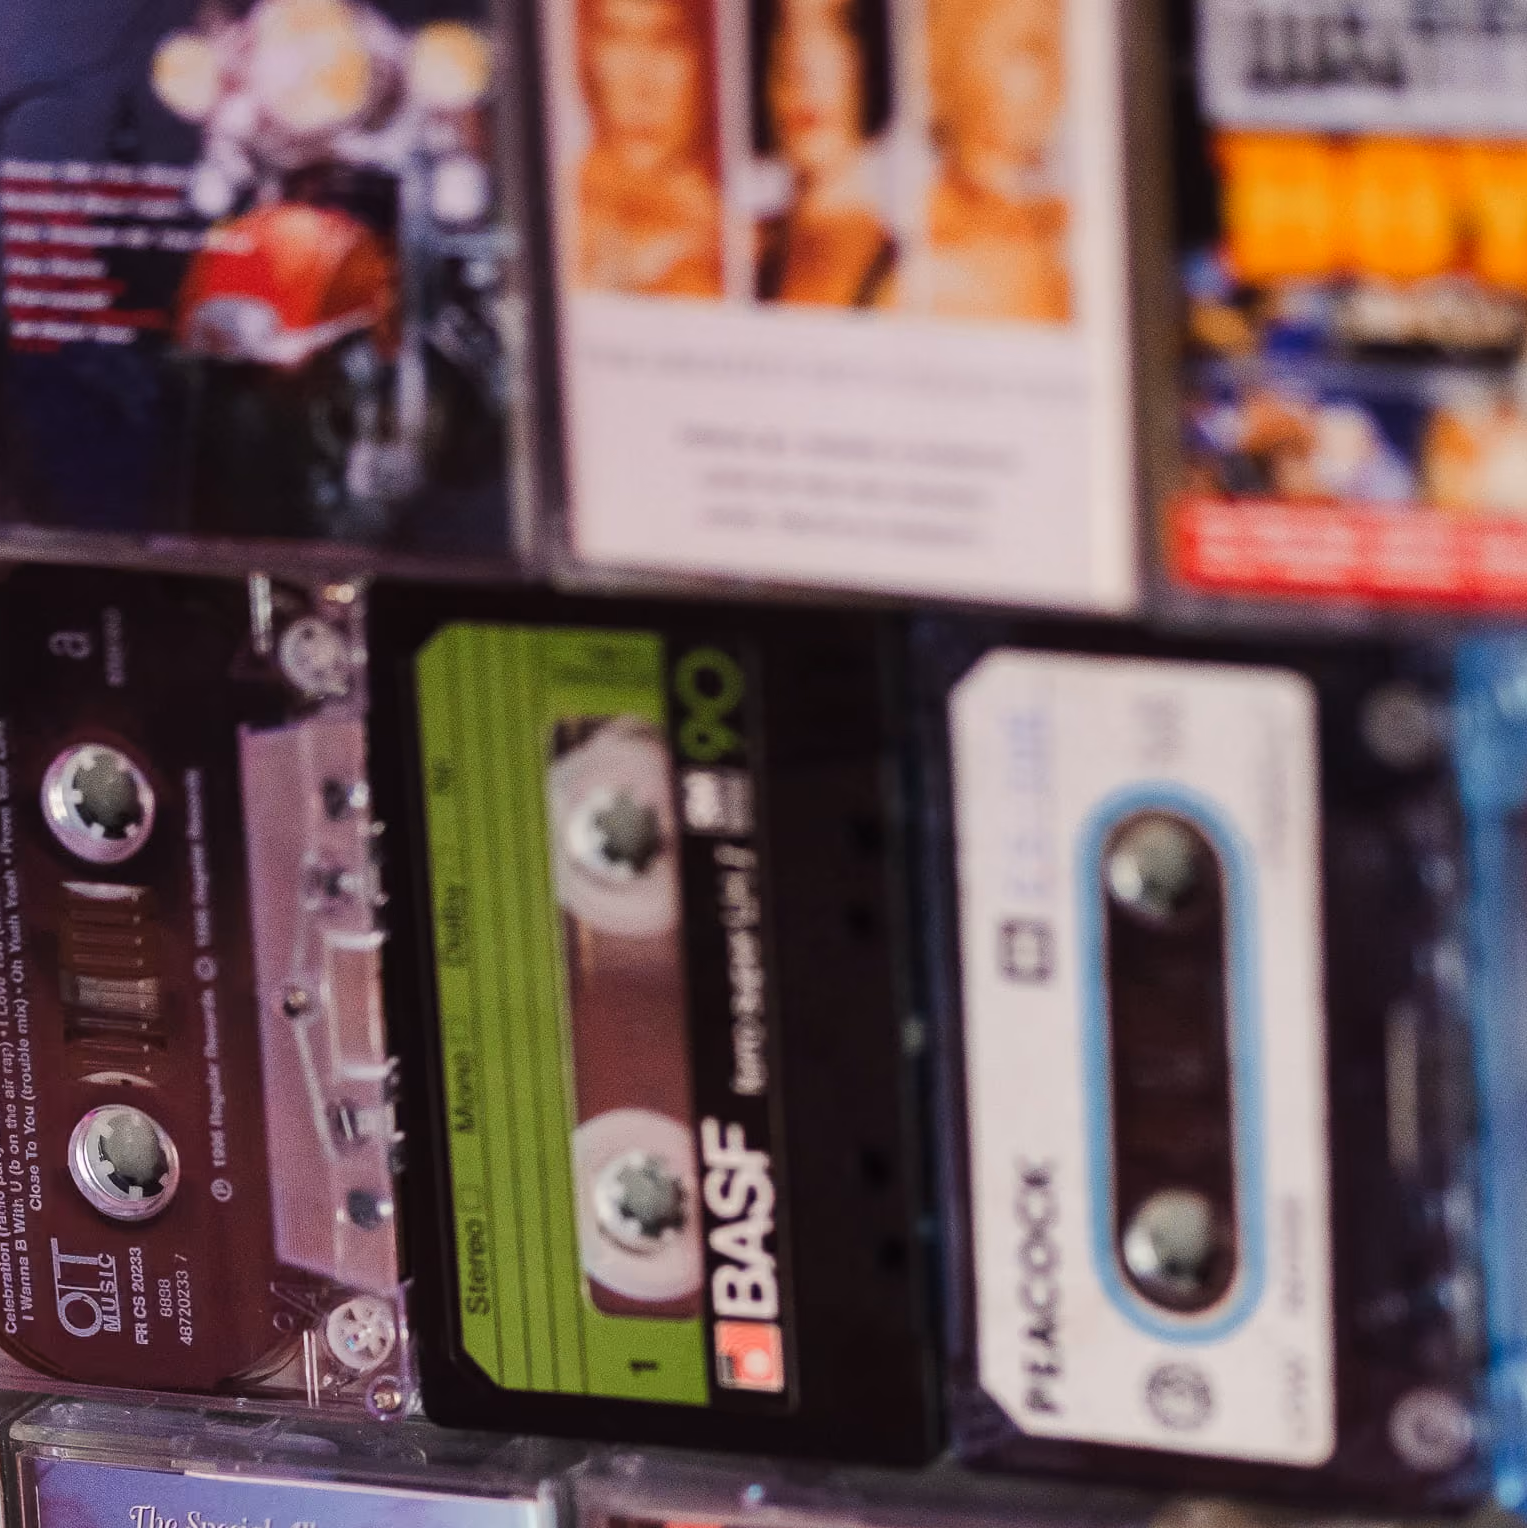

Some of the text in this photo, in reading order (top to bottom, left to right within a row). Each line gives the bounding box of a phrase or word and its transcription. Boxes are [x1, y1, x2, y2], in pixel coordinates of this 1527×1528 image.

[676, 646, 745, 761] 90
[10, 960, 25, 984] Oh
[14, 999, 31, 1035] mix)
[18, 1038, 36, 1100] (trouble
[1, 1078, 15, 1100] air
[3, 1103, 18, 1130] the
[23, 1105, 37, 1136] You
[6, 1134, 20, 1155] on
[25, 1141, 39, 1161] To
[10, 1181, 23, 1194] U
[27, 1165, 42, 1212] Close
[11, 1198, 27, 1235] With
[701, 1115, 778, 1320] BASF
[15, 1239, 28, 1252] B
[18, 1256, 33, 1311] Wanna
[128, 1247, 144, 1293] 20233
[463, 1218, 491, 1316] Stereo
[98, 1252, 121, 1332] MUSIC
[132, 1296, 147, 1319] CS
